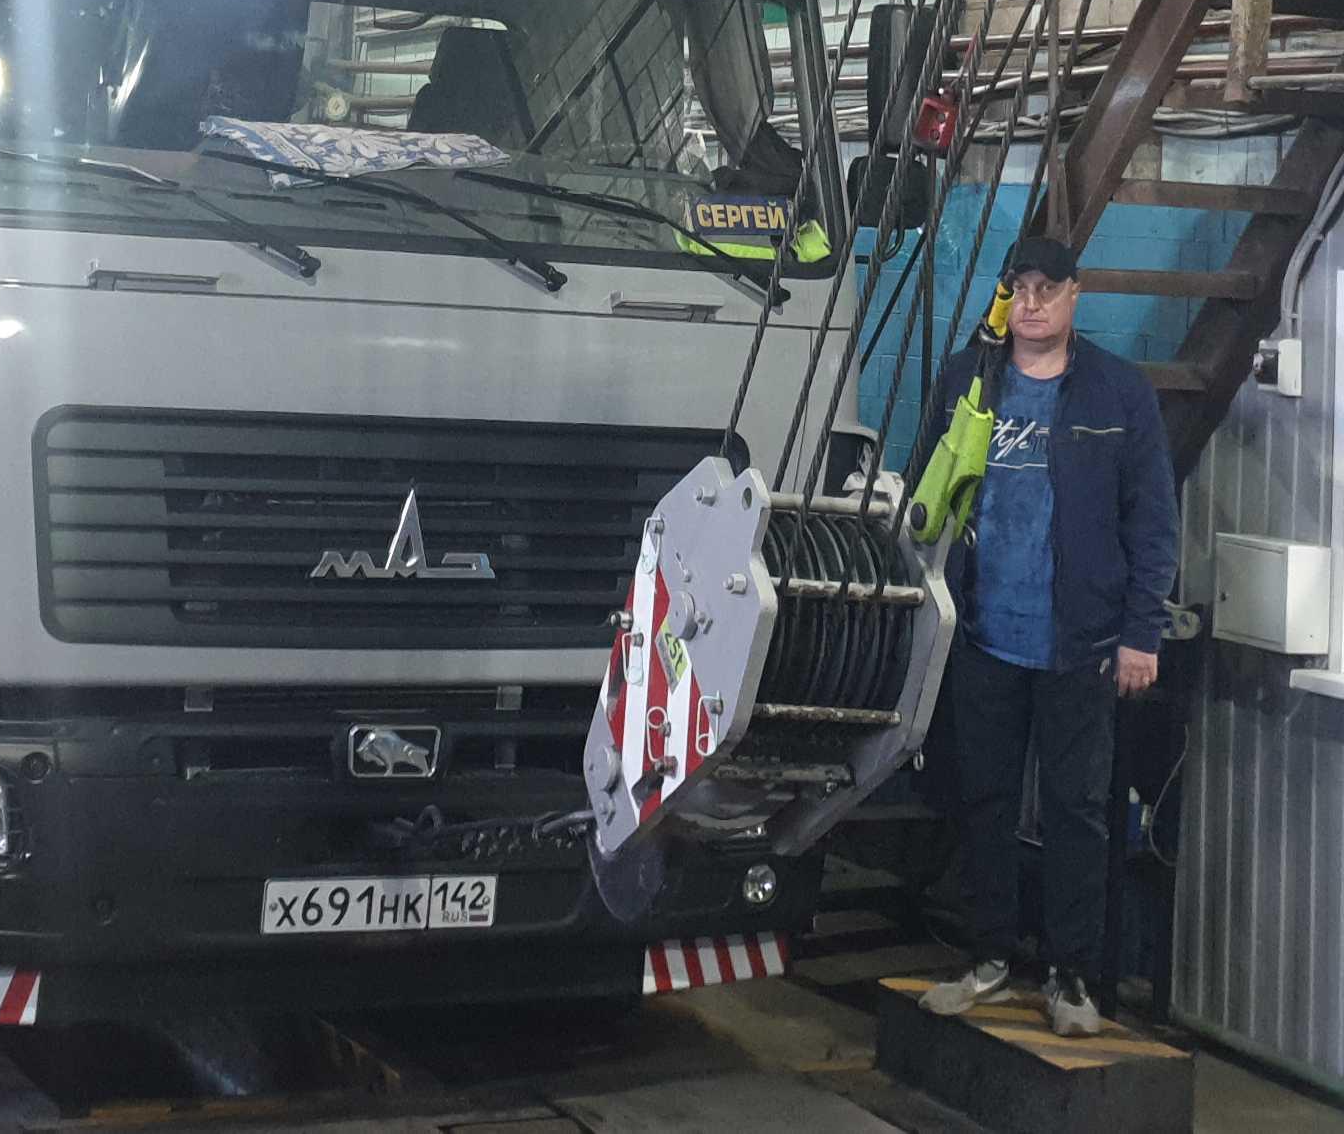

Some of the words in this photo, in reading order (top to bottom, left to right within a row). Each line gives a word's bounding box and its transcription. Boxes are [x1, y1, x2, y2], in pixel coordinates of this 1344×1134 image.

[696, 201, 786, 229] СЕРГЕЙ
[275, 885, 424, 927] Х691НК
[435, 881, 486, 911] 142
